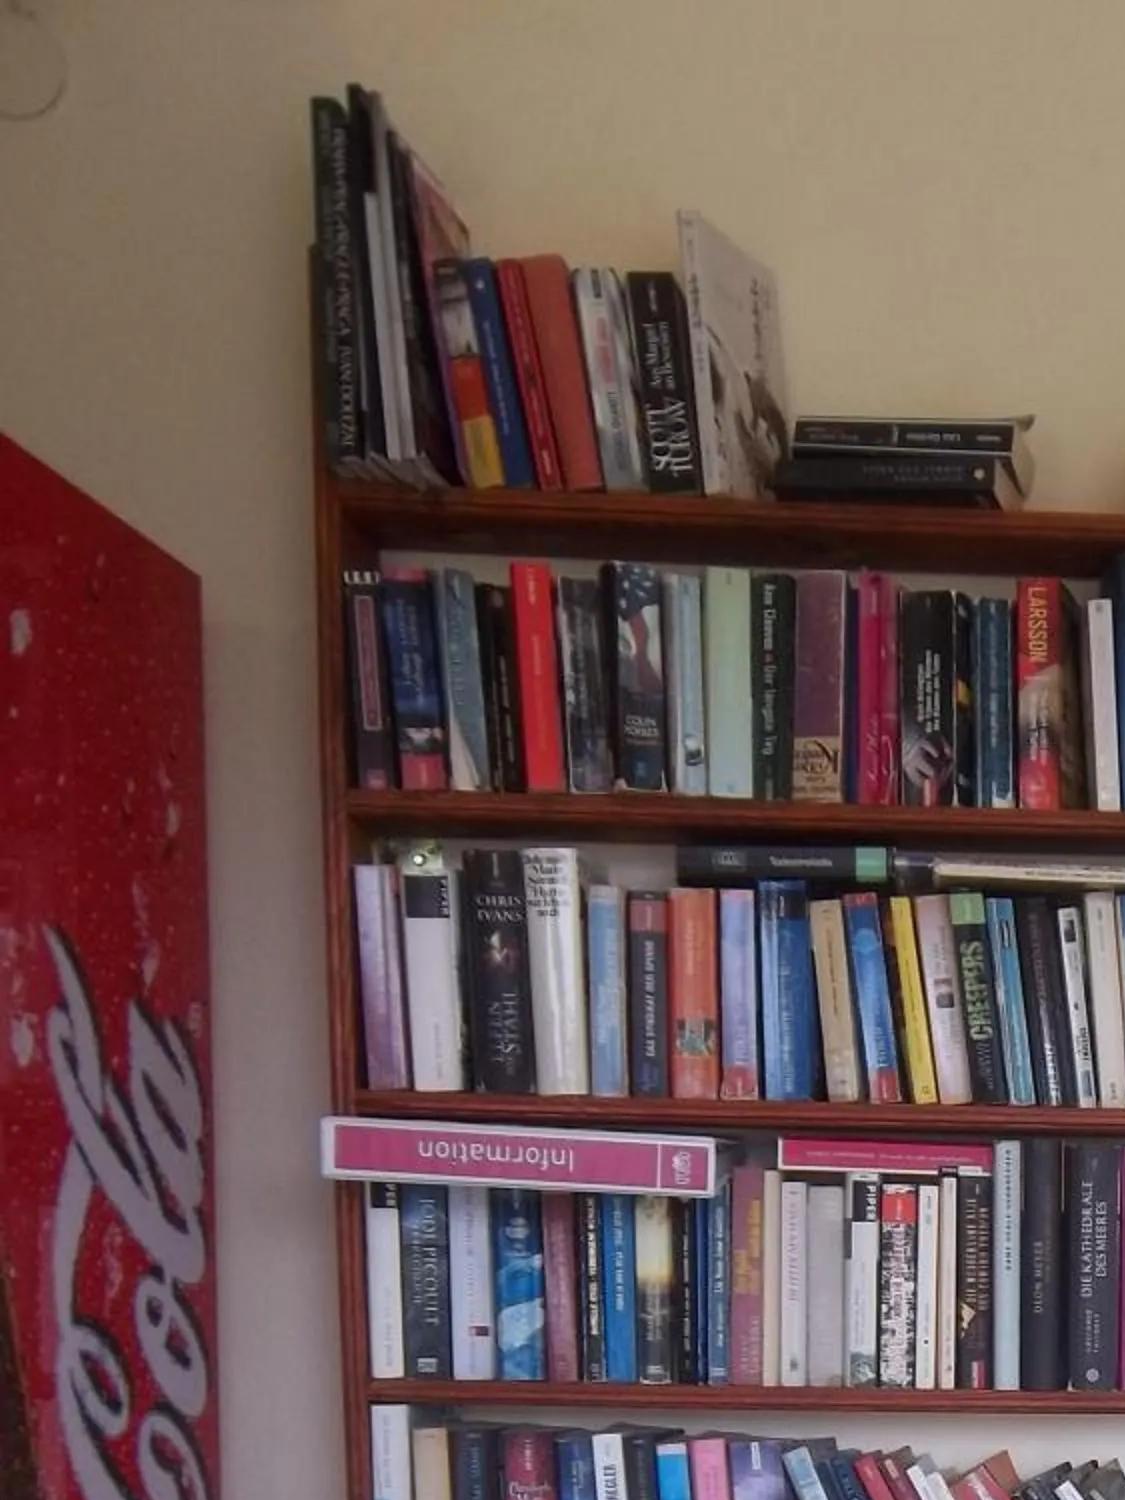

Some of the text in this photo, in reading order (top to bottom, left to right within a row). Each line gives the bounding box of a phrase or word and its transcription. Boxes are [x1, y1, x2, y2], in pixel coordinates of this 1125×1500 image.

[644, 402, 670, 472] SCOTT
[664, 395, 694, 477] TUROW
[1027, 586, 1049, 663] LARSSON
[959, 940, 994, 1042] CREEPERS
[415, 1138, 574, 1173] Information
[1081, 1181, 1094, 1299] DIE KATHEDRALE
[1095, 1201, 1108, 1278] DES MEERES
